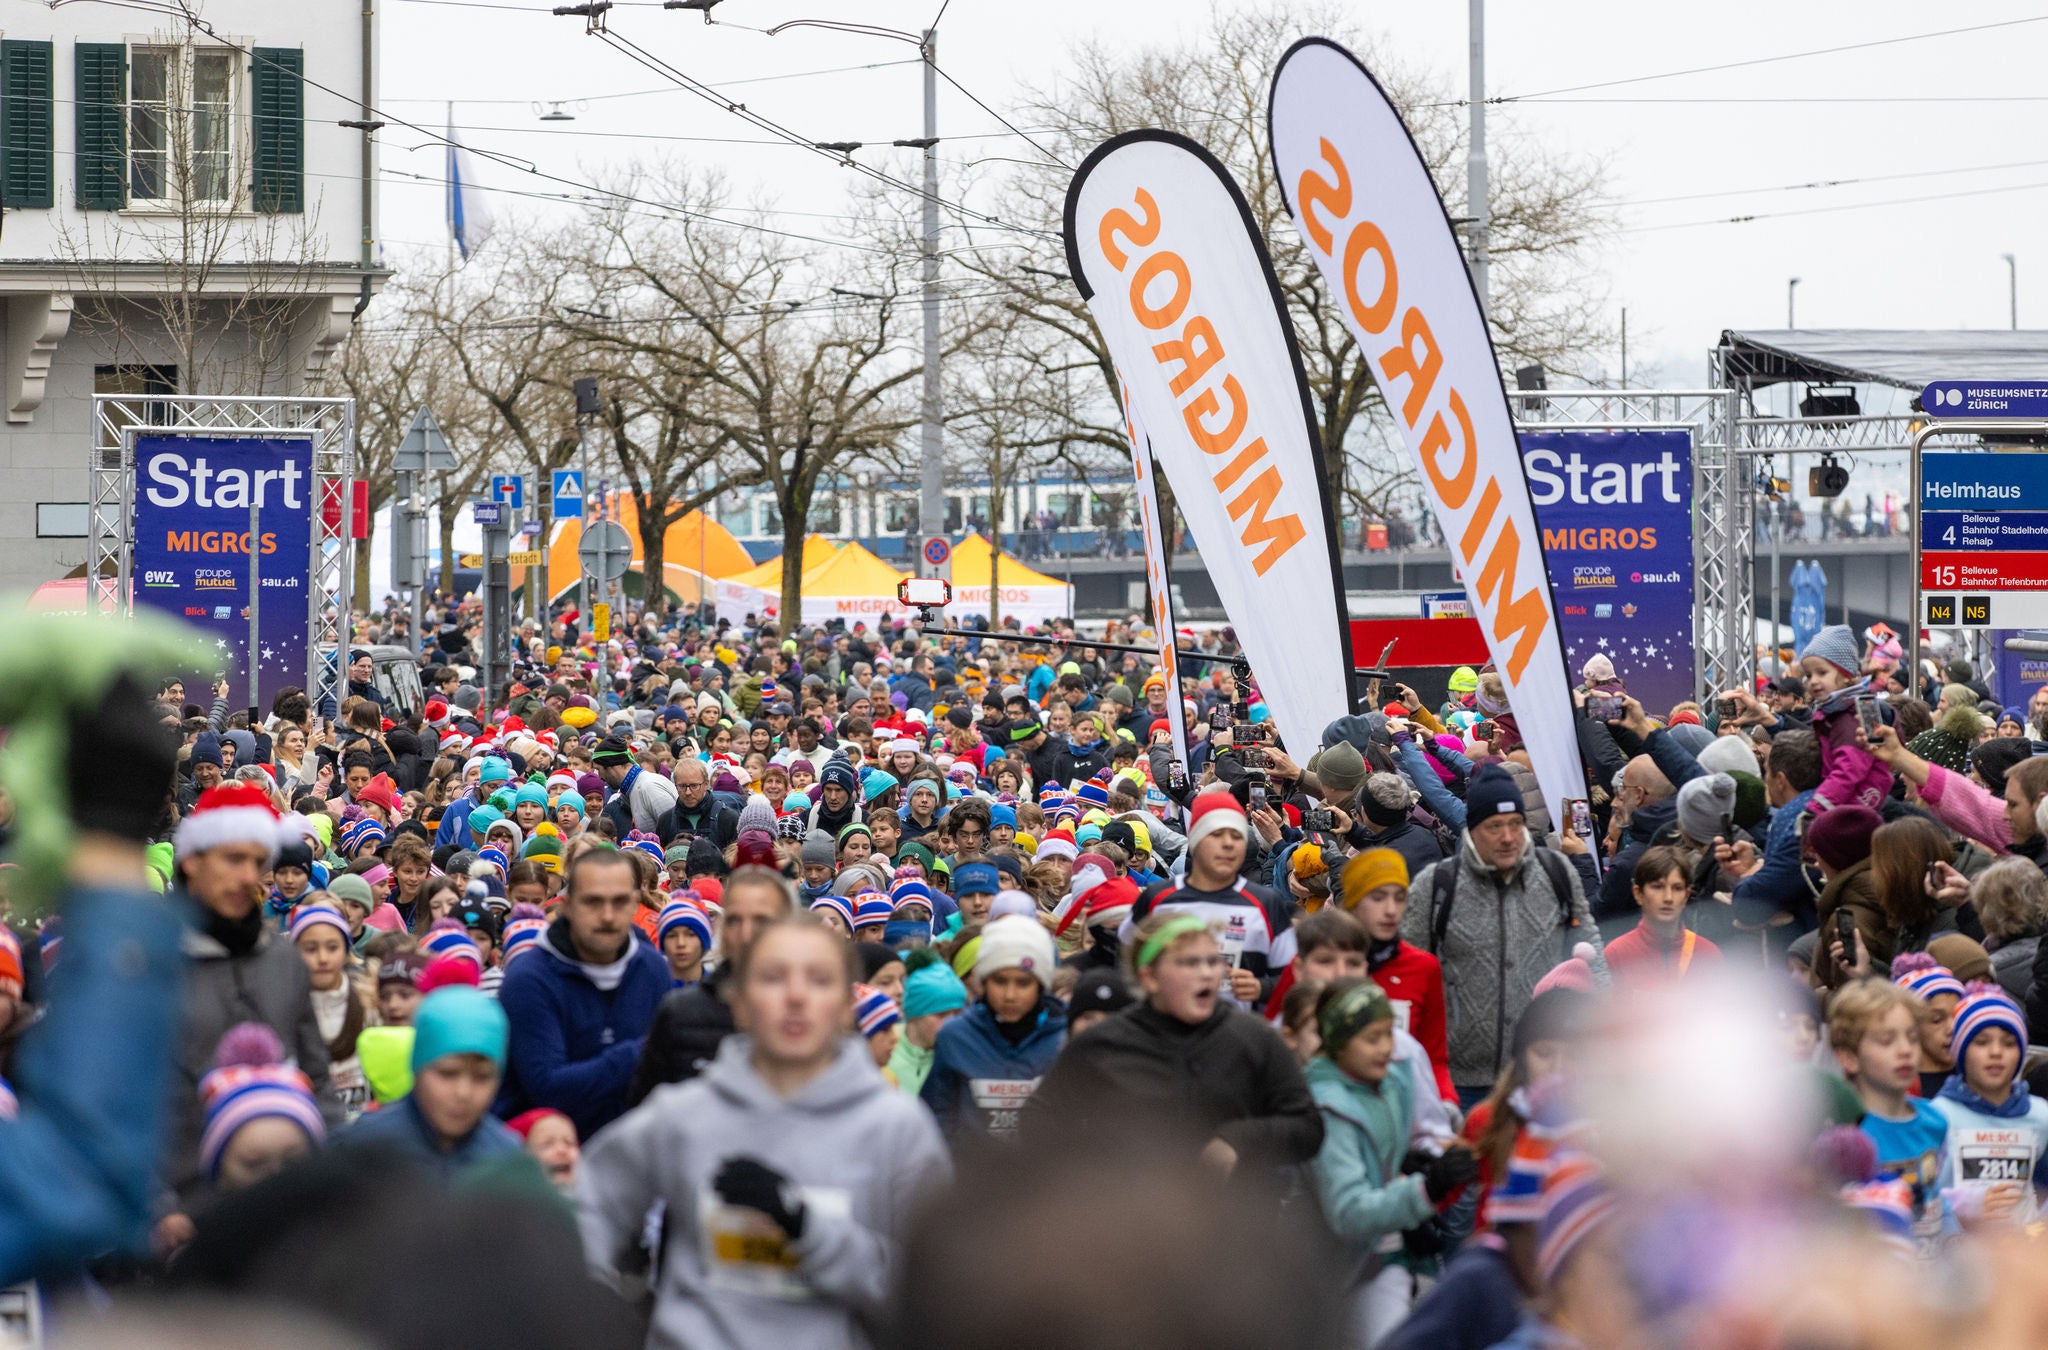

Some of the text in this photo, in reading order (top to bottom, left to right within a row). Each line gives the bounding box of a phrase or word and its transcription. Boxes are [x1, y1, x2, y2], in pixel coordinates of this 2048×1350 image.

[1967, 388, 2048, 398] MUSEUMSNETZ
[1967, 399, 2008, 410] ZÜRICH
[146, 453, 303, 510] Start
[1523, 448, 1681, 506] Start
[1926, 481, 2021, 499] Helmhaus
[1962, 514, 2000, 523] Bellevue
[1942, 525, 1957, 546] 4
[1962, 525, 1999, 535] Bahnhof
[167, 531, 277, 555] MIGROS
[1543, 527, 1657, 550] MIGROS
[1962, 536, 1994, 547] Rehalp
[194, 568, 232, 579] groupe
[1573, 566, 1612, 577] groupe
[1642, 570, 1681, 583] sau.ch
[1931, 565, 1956, 586] 15
[1961, 566, 1998, 574] Bellevue
[144, 570, 175, 584] ewz
[195, 577, 236, 588] mutuel
[261, 576, 299, 588] sau.ch
[1573, 575, 1616, 585] mutuel
[1961, 577, 1998, 586] Bahnhof
[836, 600, 909, 614] MIGROS
[1931, 606, 1986, 619] N4 N5
[1974, 1131, 2019, 1144] MERCI
[1978, 1159, 2019, 1179] 2814
